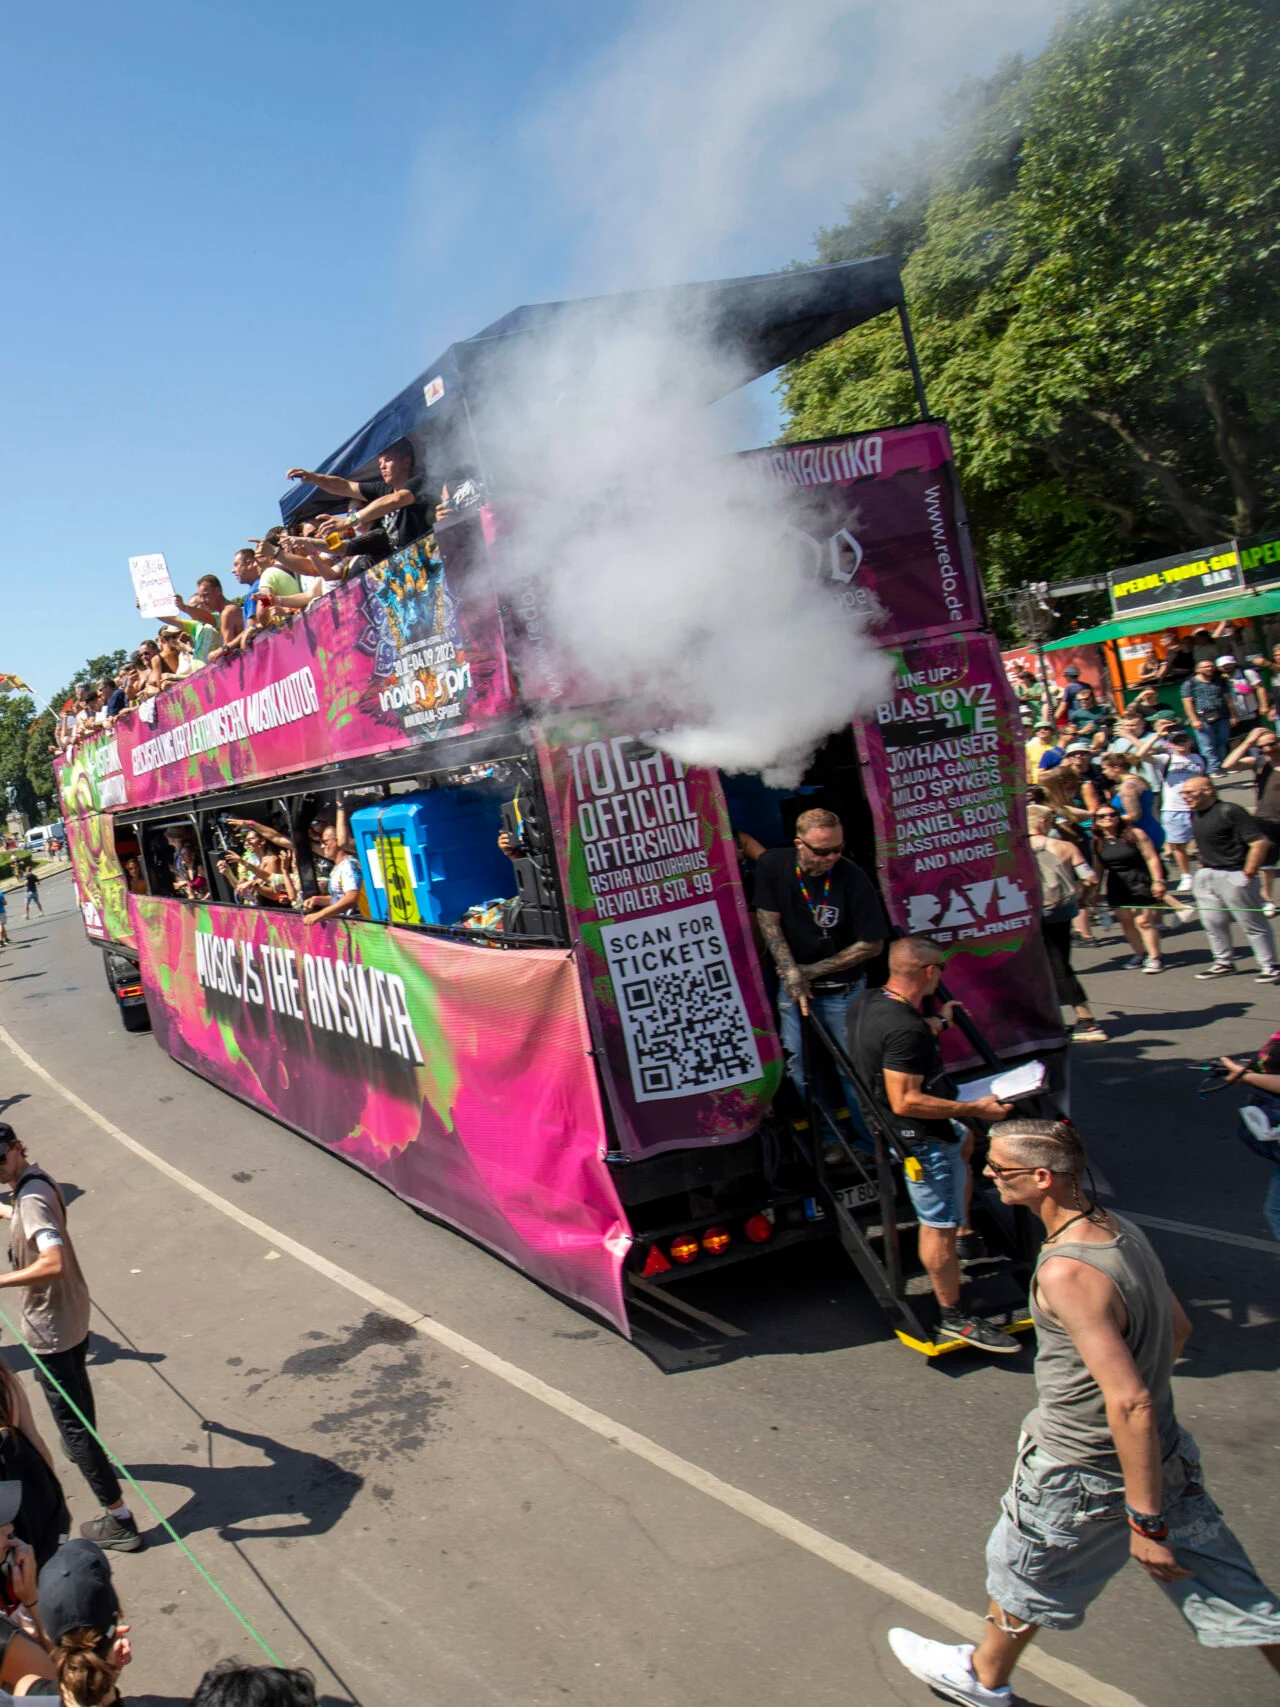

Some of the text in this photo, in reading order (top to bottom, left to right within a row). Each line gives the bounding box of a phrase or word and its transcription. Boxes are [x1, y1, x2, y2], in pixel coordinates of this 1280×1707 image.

[924, 484, 964, 621] www.redo.de
[517, 574, 564, 698] www.redo.
[895, 666, 958, 690] LINE UP:
[875, 683, 997, 725] BLASTOYZ
[886, 733, 1000, 773] JOYHAUSER
[890, 754, 1000, 789] KLAUDIA GAWLAS
[892, 769, 1002, 807] MILO SPYKERS
[577, 781, 697, 843] OFFICIAL
[894, 800, 947, 821] VANESSA
[895, 801, 1009, 841] DANIEL BOON
[583, 819, 700, 873] AFTERSHOW
[897, 820, 1011, 857] BASSTRONAUTEN
[588, 850, 708, 894] ASTRA KULTURHAUS
[914, 853, 947, 873] AND
[594, 872, 714, 919] REVALER STR. 99
[610, 915, 715, 954] SCAN FOR
[958, 915, 1032, 940] PLANET
[611, 935, 723, 978] TICKETS
[195, 930, 425, 1064] MUSIC IS THE ANSWER
